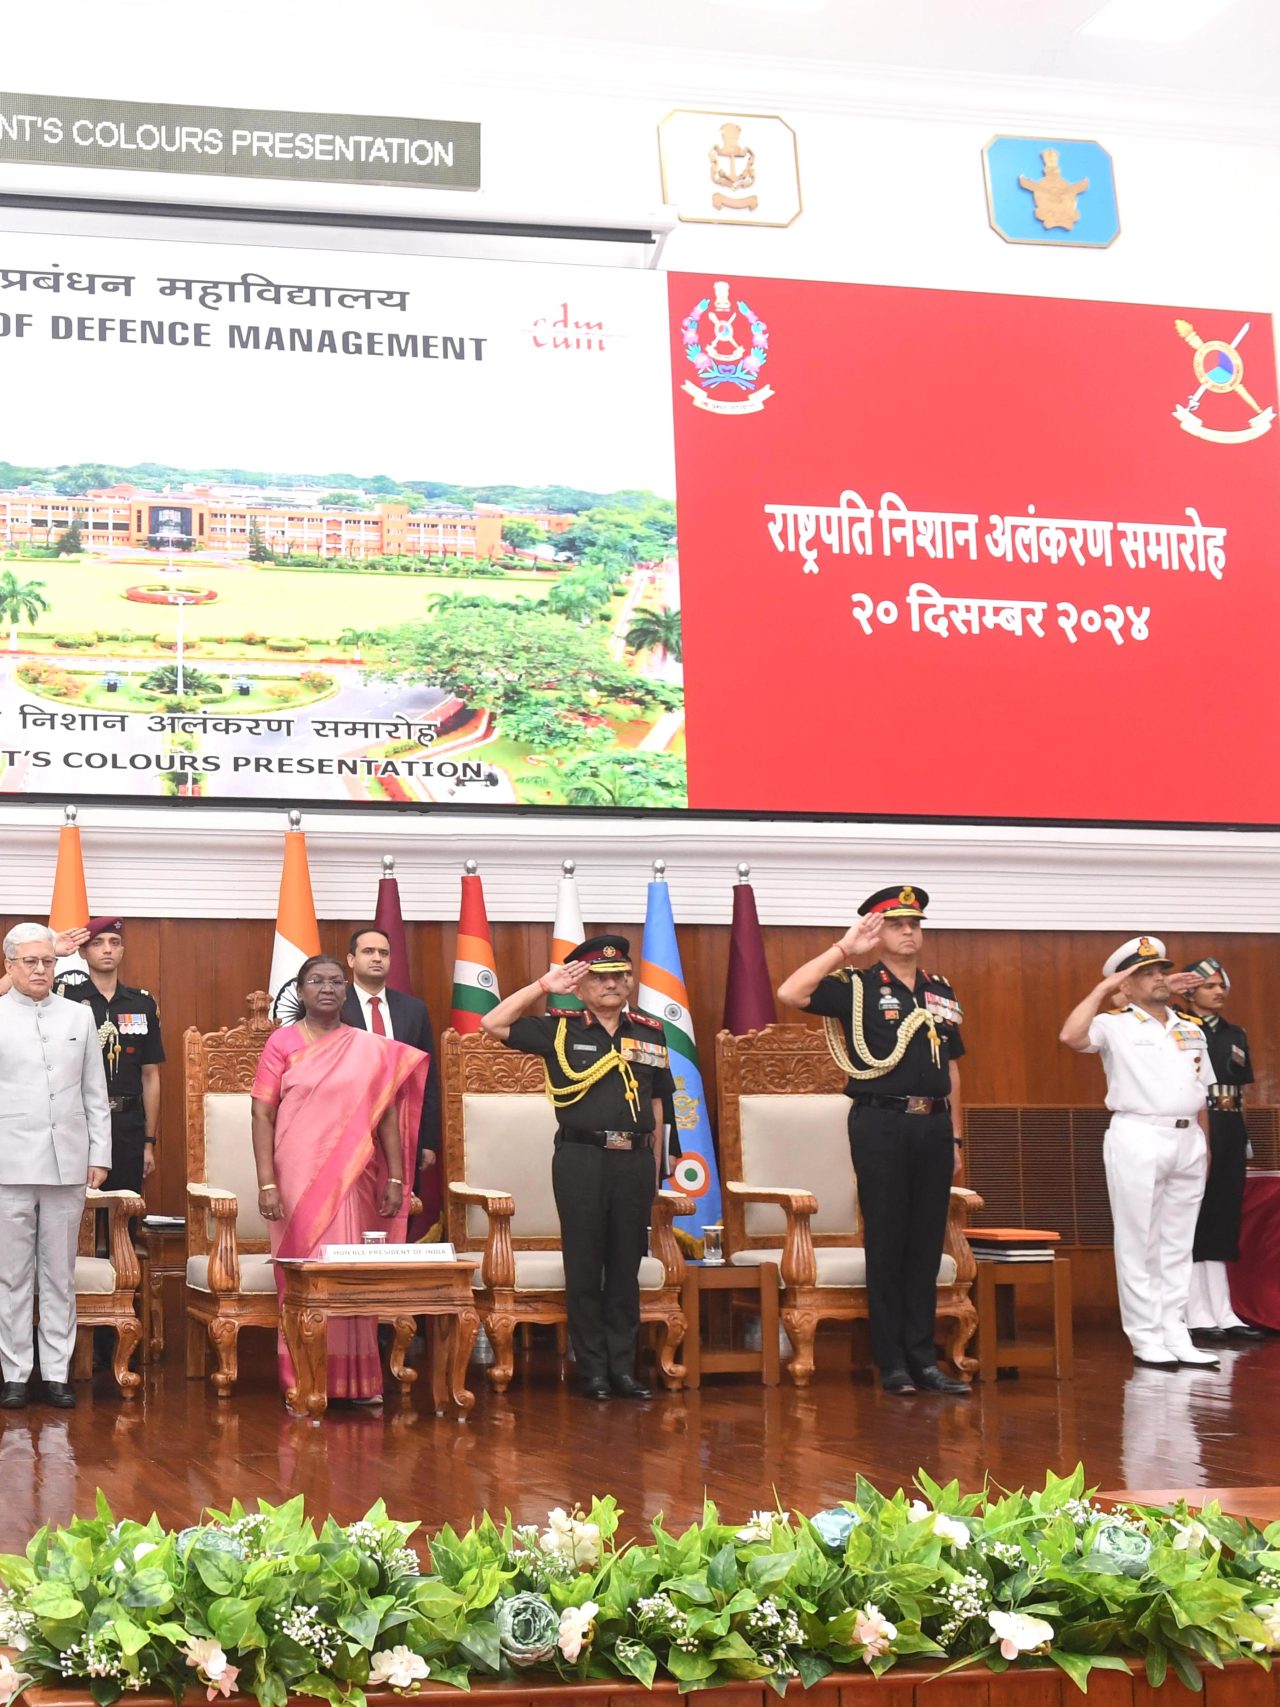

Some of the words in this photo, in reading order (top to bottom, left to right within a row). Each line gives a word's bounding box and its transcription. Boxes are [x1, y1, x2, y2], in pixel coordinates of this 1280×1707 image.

[73, 120, 223, 155] COLOURS
[232, 129, 454, 167] PRESENTATION
[0, 263, 136, 297] प्रबंधन
[157, 273, 410, 312] महाविद्यालय
[51, 315, 211, 347] DEFENCE
[228, 324, 488, 361] MANAGEMENT
[764, 489, 874, 574] राष्ट्रपति
[878, 491, 979, 560] निशान
[984, 503, 1114, 567] अलंकरण
[1116, 506, 1227, 580] समारोह
[851, 592, 898, 635] २०
[906, 582, 1048, 638] दिसम्बर
[1055, 601, 1151, 646] २०२४
[19, 704, 129, 732] निशान
[147, 710, 295, 737] अलंकरण
[311, 712, 438, 746] समारोह
[63, 752, 220, 772] COLOURS
[233, 757, 484, 779] PRESENTATION
